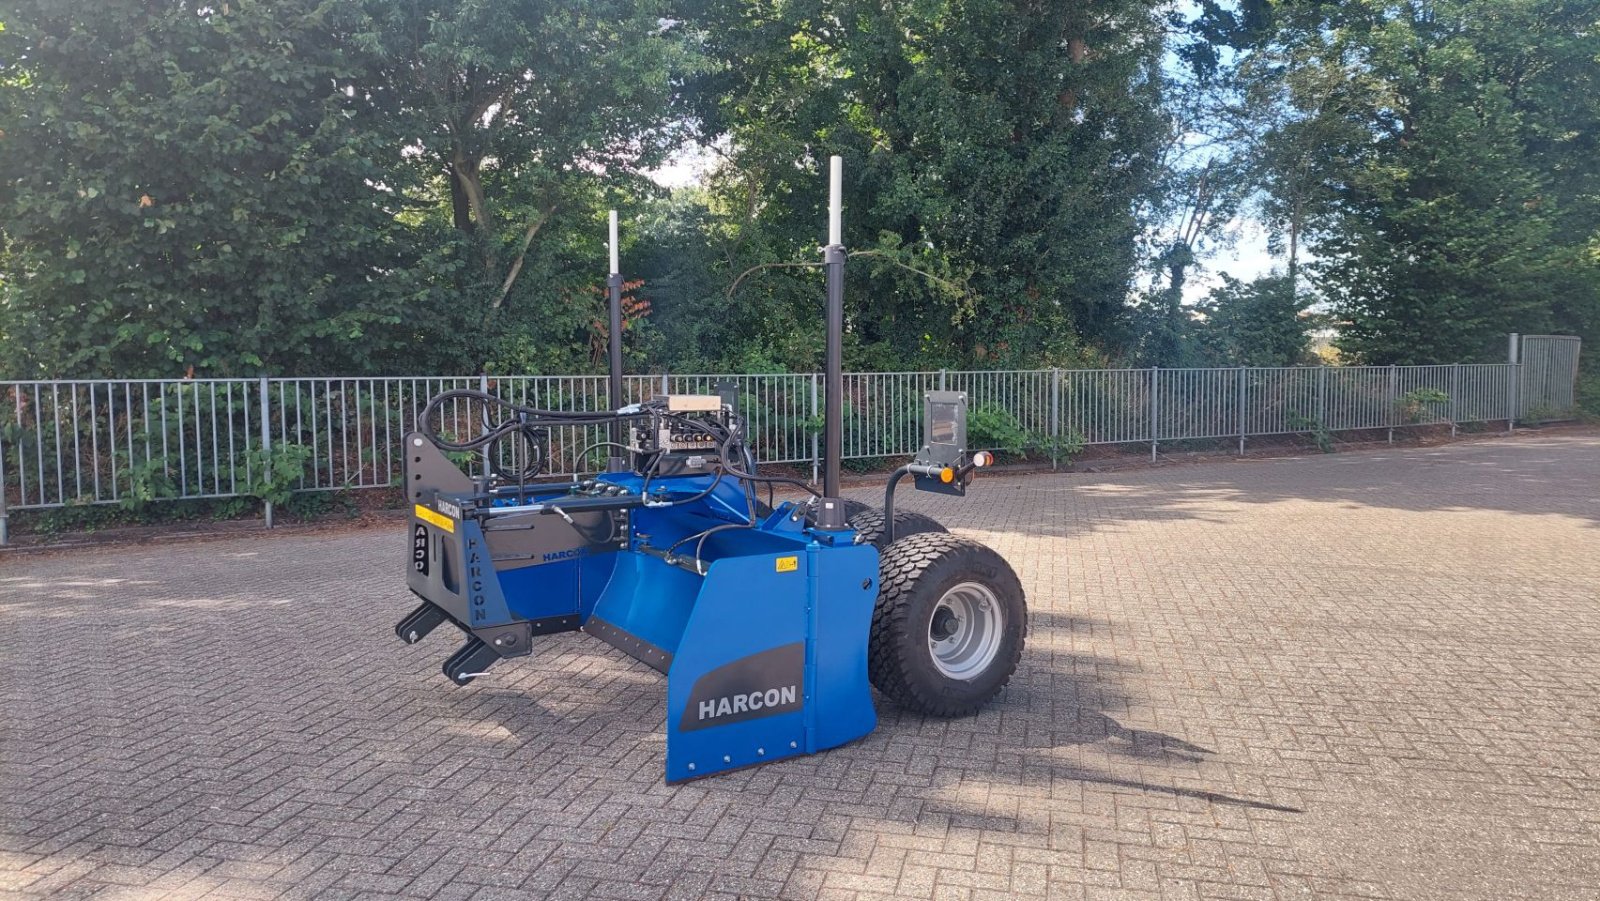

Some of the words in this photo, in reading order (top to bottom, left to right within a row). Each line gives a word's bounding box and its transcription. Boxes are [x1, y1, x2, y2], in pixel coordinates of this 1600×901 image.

[437, 499, 460, 519] HARCON
[468, 538, 486, 621] HARCON
[699, 685, 796, 720] HARCON
